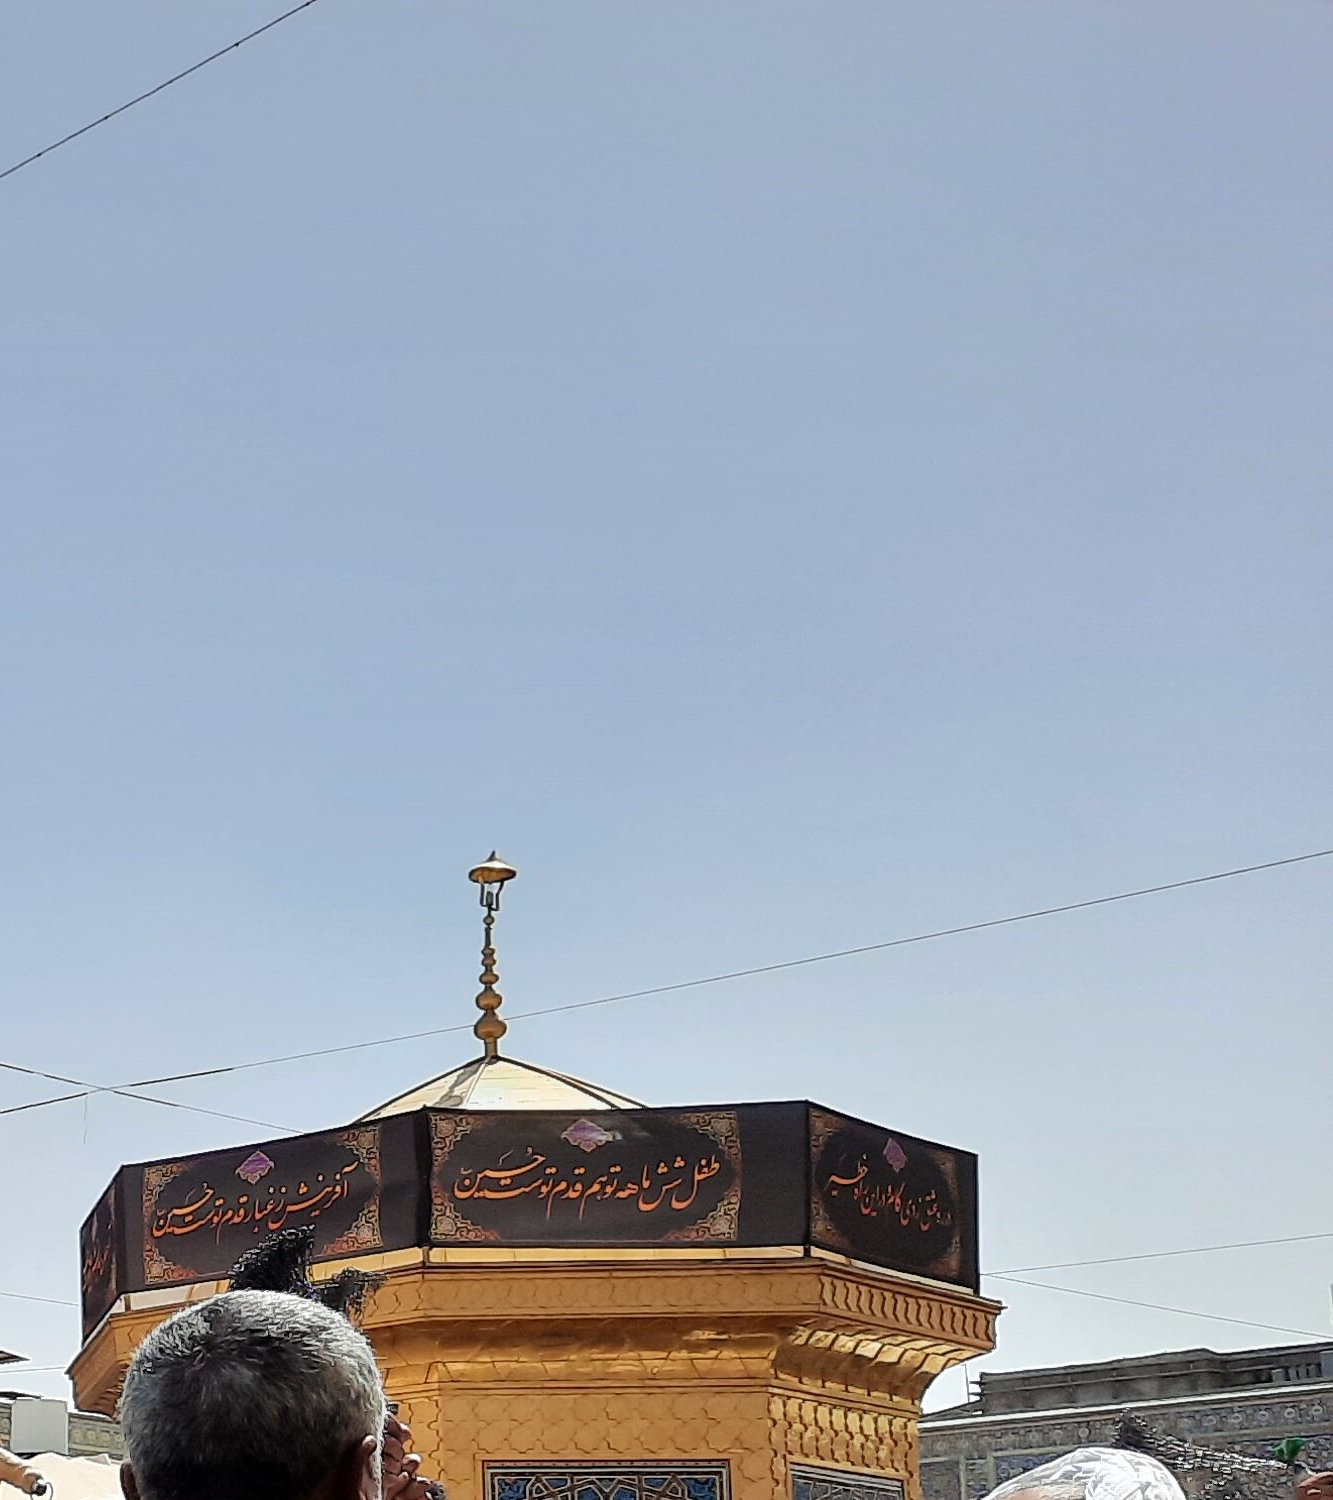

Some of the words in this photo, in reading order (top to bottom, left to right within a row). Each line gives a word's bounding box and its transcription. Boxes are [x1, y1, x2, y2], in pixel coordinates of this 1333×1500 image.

[637, 1156, 686, 1212] شش
[670, 1154, 722, 1211] طفل
[215, 1195, 249, 1246] قدم
